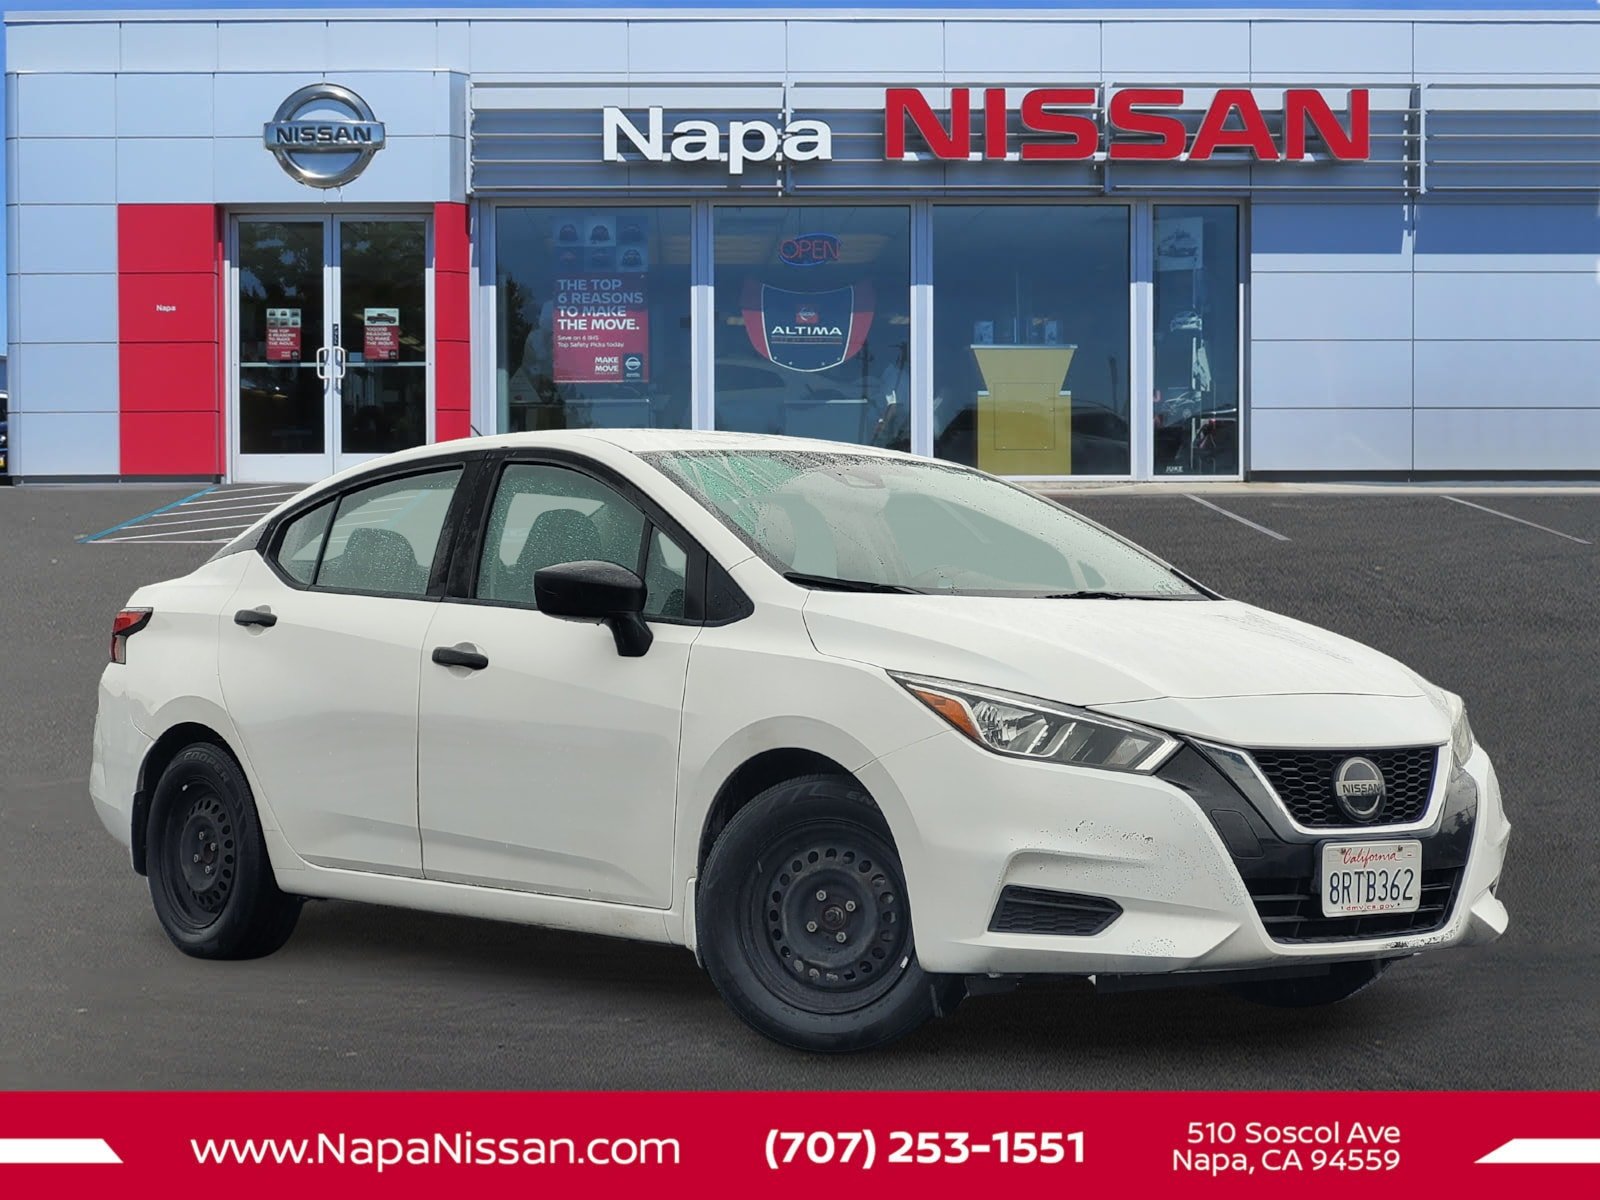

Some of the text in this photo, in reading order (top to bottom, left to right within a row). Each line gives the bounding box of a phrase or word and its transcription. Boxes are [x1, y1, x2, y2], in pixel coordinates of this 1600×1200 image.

[275, 126, 372, 143] NISSAN
[603, 88, 1369, 174] Napa NISSAN
[780, 239, 840, 260] OPEN
[557, 279, 622, 291] THE TOP
[557, 292, 644, 304] 6 REASONS
[156, 304, 176, 312] Napa
[557, 306, 627, 317] TO MAKE
[557, 319, 640, 330] THE MOVE.
[771, 326, 842, 335] ALTIMA
[1342, 783, 1381, 794] NISSAN
[1343, 848, 1400, 868] California
[1329, 869, 1414, 905] 8RTB362
[1346, 903, 1396, 911] dmv.ca.gov
